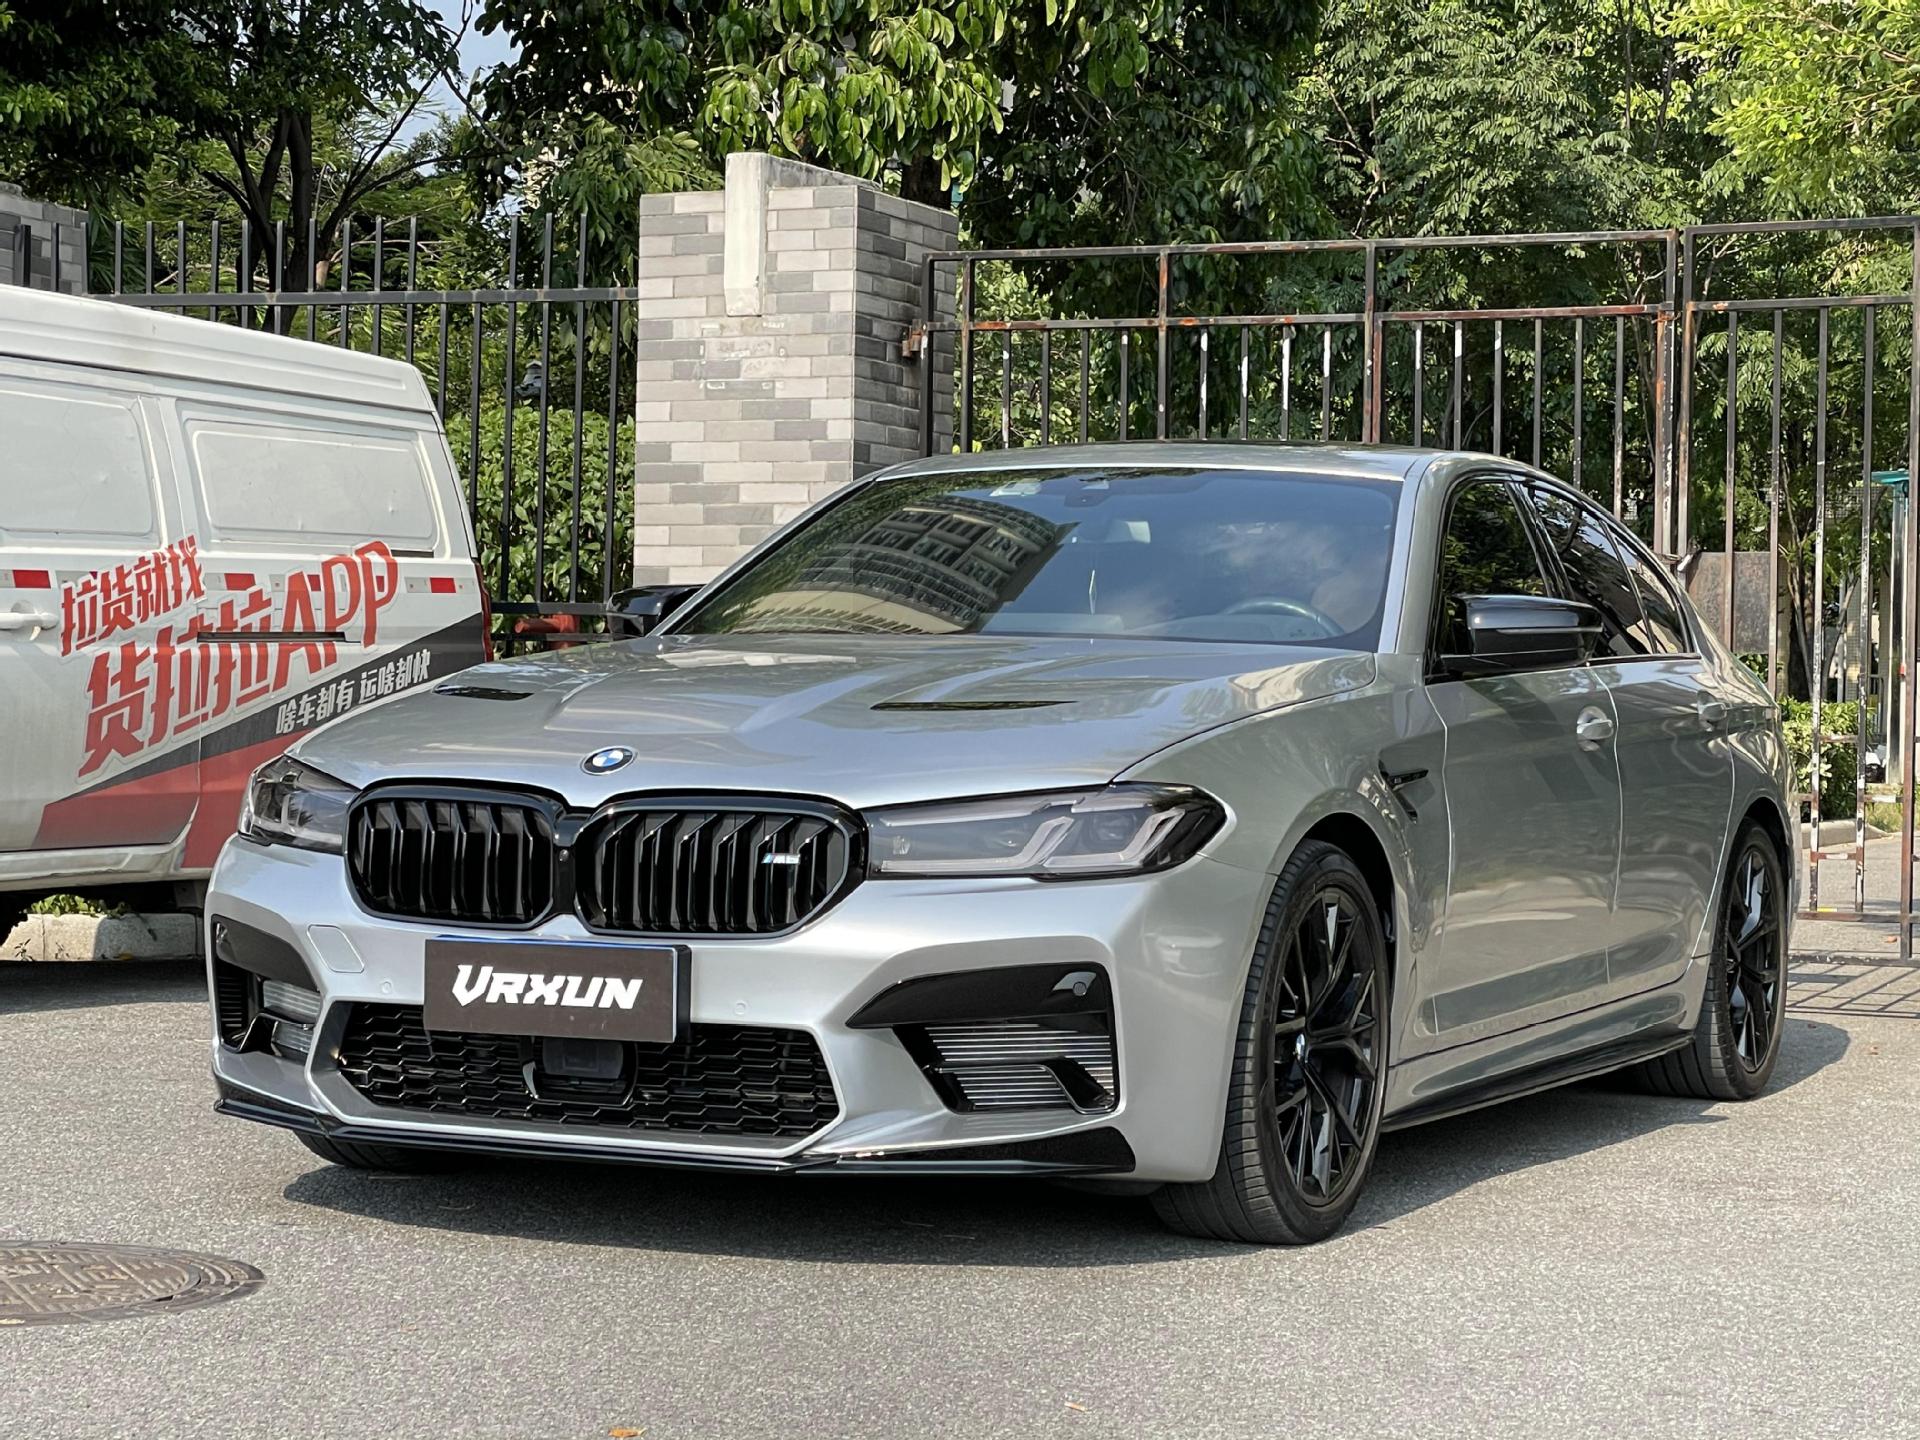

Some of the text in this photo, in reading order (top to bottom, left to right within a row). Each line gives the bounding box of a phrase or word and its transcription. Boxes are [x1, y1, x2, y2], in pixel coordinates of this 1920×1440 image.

[60, 535, 204, 657] 拉货就找
[78, 540, 398, 777] 货拉拉APP
[276, 649, 430, 734] 啥车都有 运啥都快
